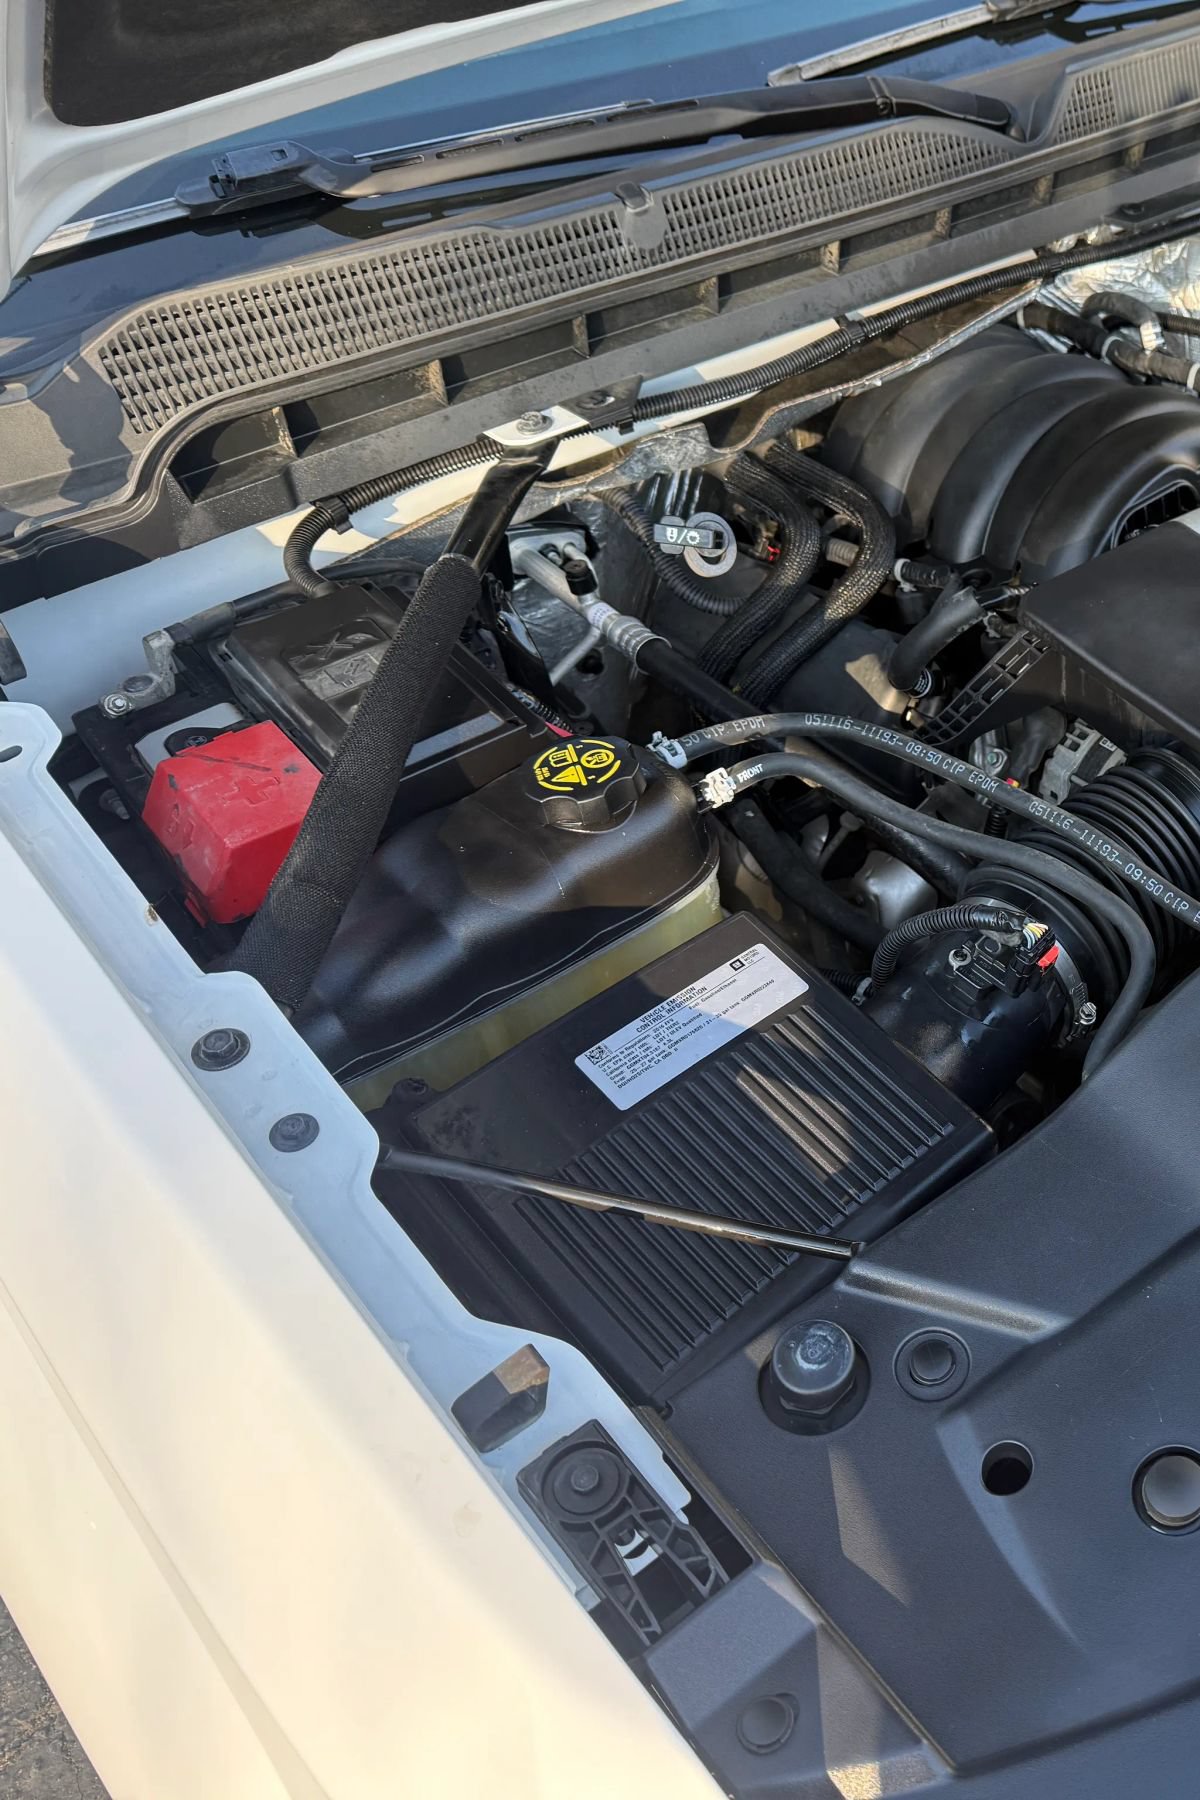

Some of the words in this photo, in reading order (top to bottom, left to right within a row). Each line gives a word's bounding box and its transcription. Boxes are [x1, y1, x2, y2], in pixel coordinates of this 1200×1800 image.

[736, 763, 763, 783] FRONT
[636, 1014, 666, 1033] CONTROL
[665, 986, 708, 1015] INFORMATION
[640, 1006, 666, 1023] VEHICLE
[666, 986, 696, 1007] EMISSION
